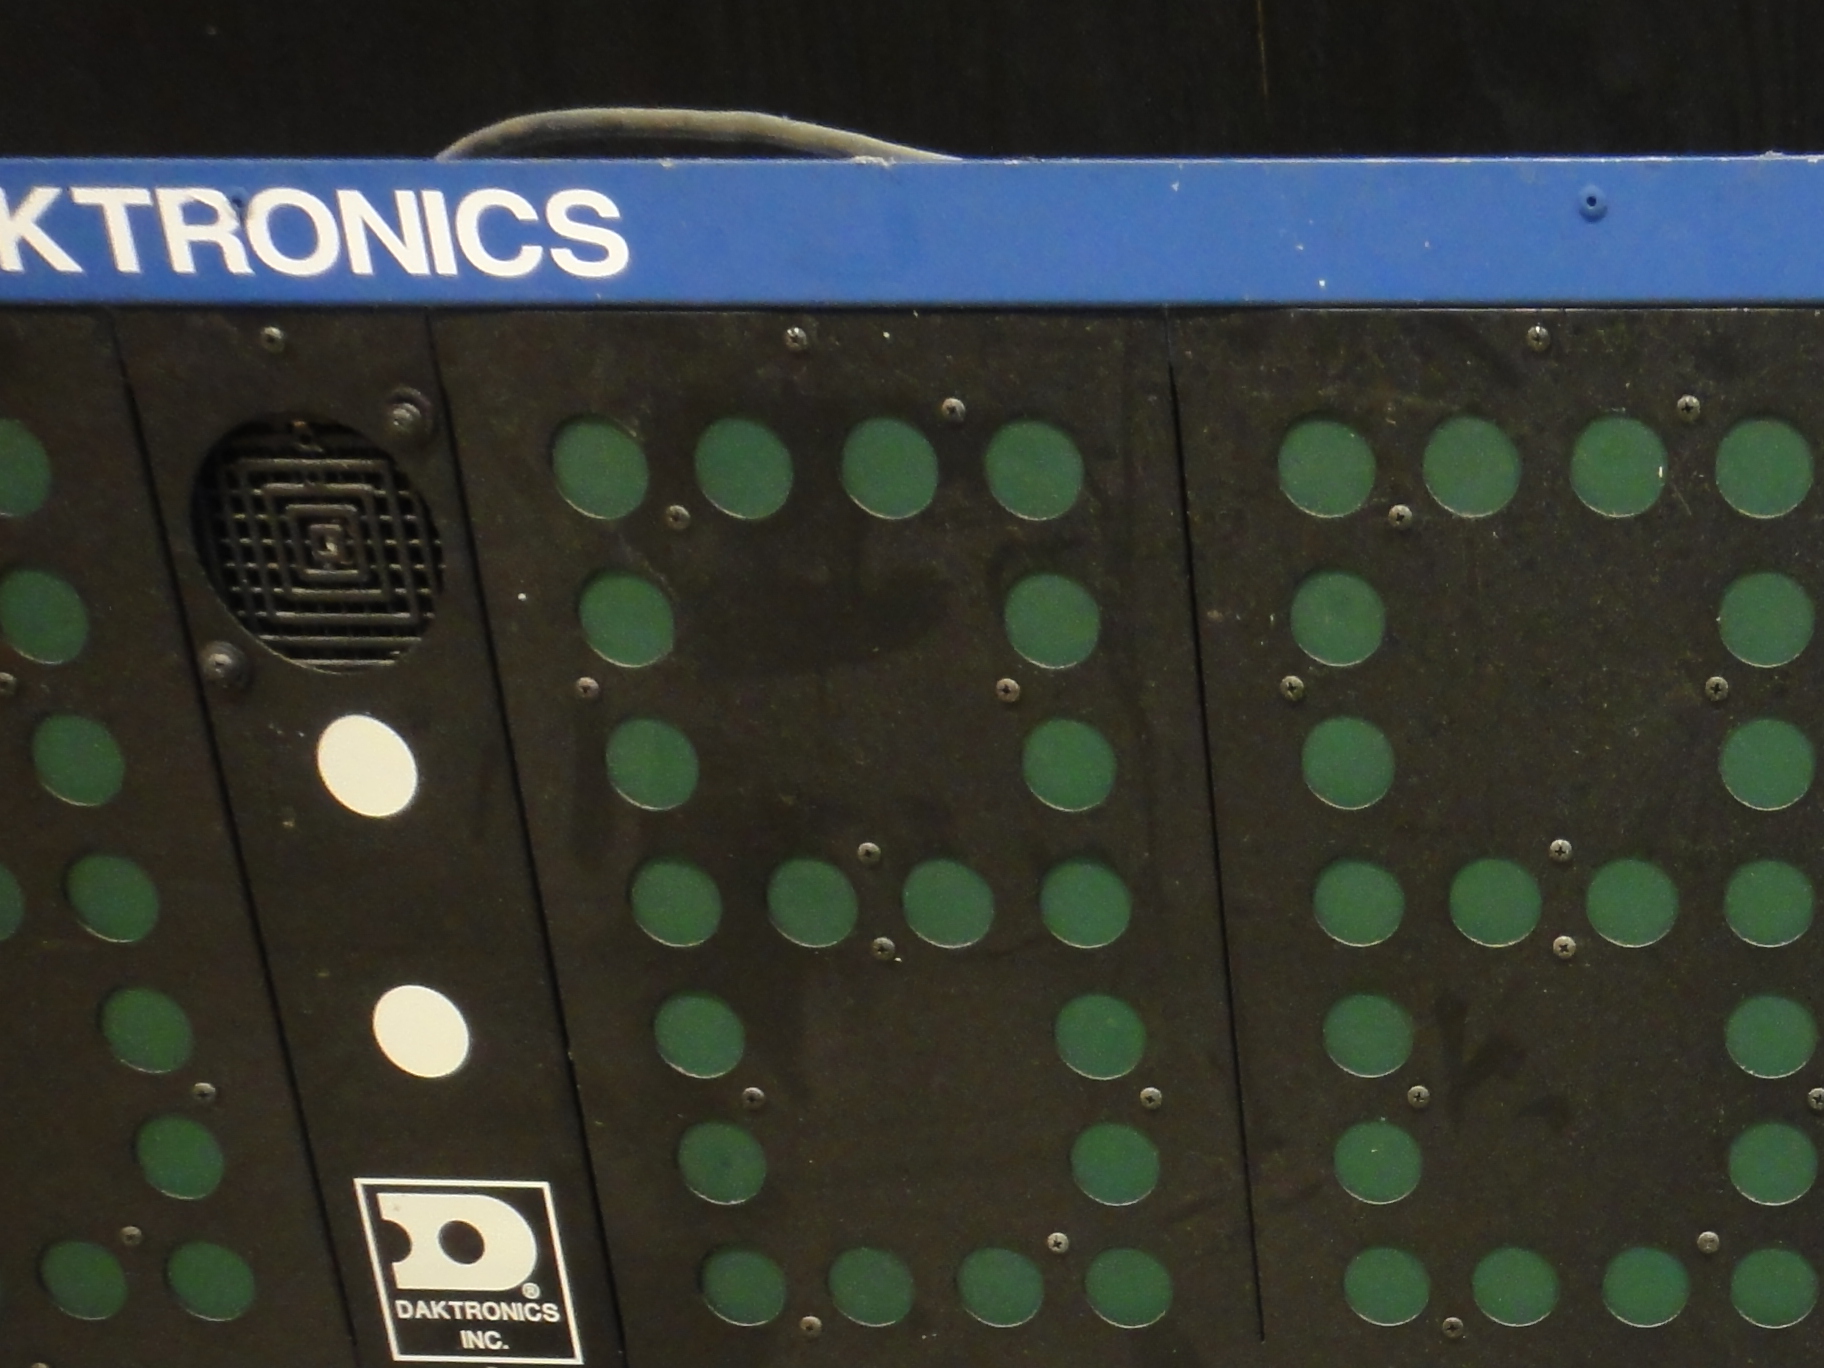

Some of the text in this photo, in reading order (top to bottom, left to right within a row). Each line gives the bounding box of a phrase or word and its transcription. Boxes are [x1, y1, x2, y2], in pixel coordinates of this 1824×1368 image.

[0, 186, 630, 278] KTRONICS
[395, 1300, 561, 1323] DAKTRONICS
[459, 1330, 510, 1350] INC.
